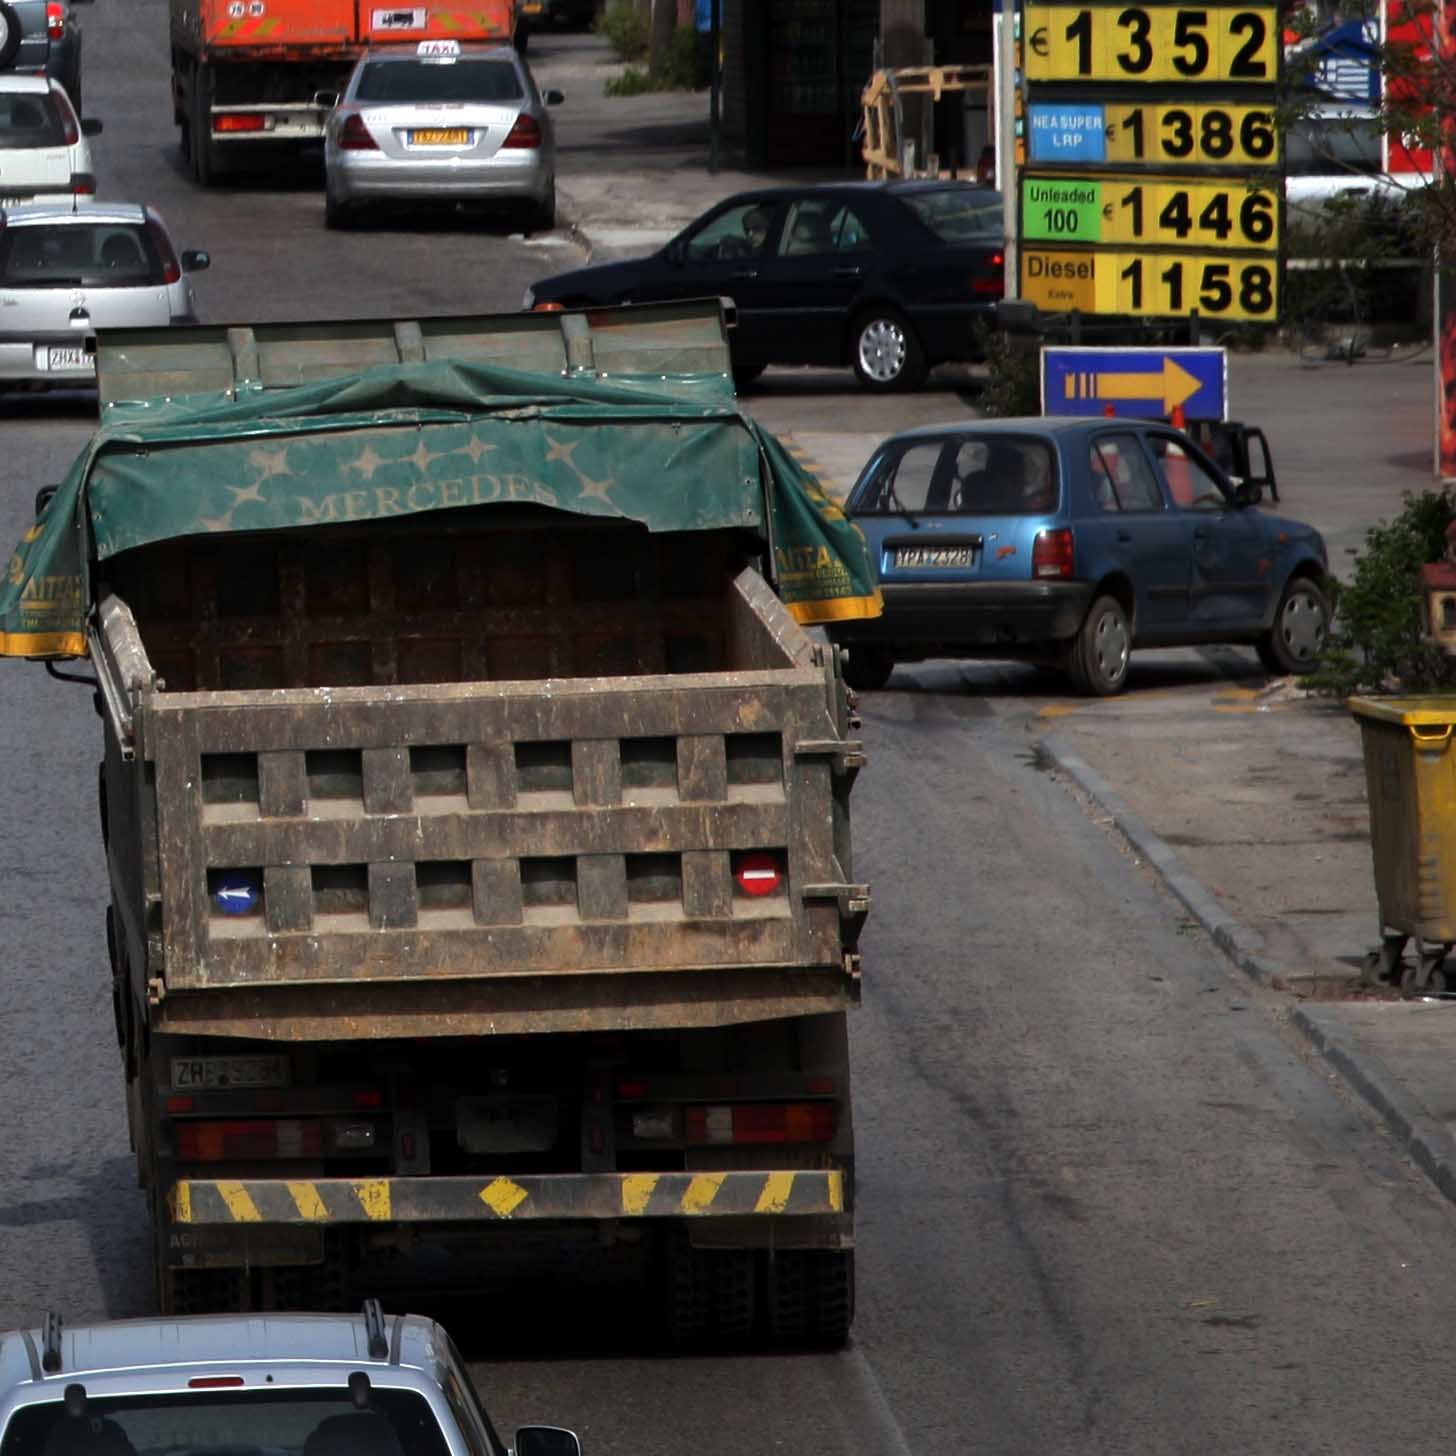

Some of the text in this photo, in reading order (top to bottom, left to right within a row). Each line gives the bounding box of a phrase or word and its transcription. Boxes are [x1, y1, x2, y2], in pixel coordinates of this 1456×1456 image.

[424, 44, 455, 55] TAXI
[1064, 8, 1268, 78] 1352
[1061, 114, 1103, 130] SUPER
[1121, 108, 1276, 159] 1386
[1052, 132, 1084, 148] LRP
[1029, 186, 1095, 206] Unleaded
[1043, 209, 1079, 234] 100
[1120, 186, 1274, 242] 1446
[1027, 255, 1095, 280] Diesel
[1120, 258, 1274, 313] 1158
[298, 475, 558, 521] MERCEDES
